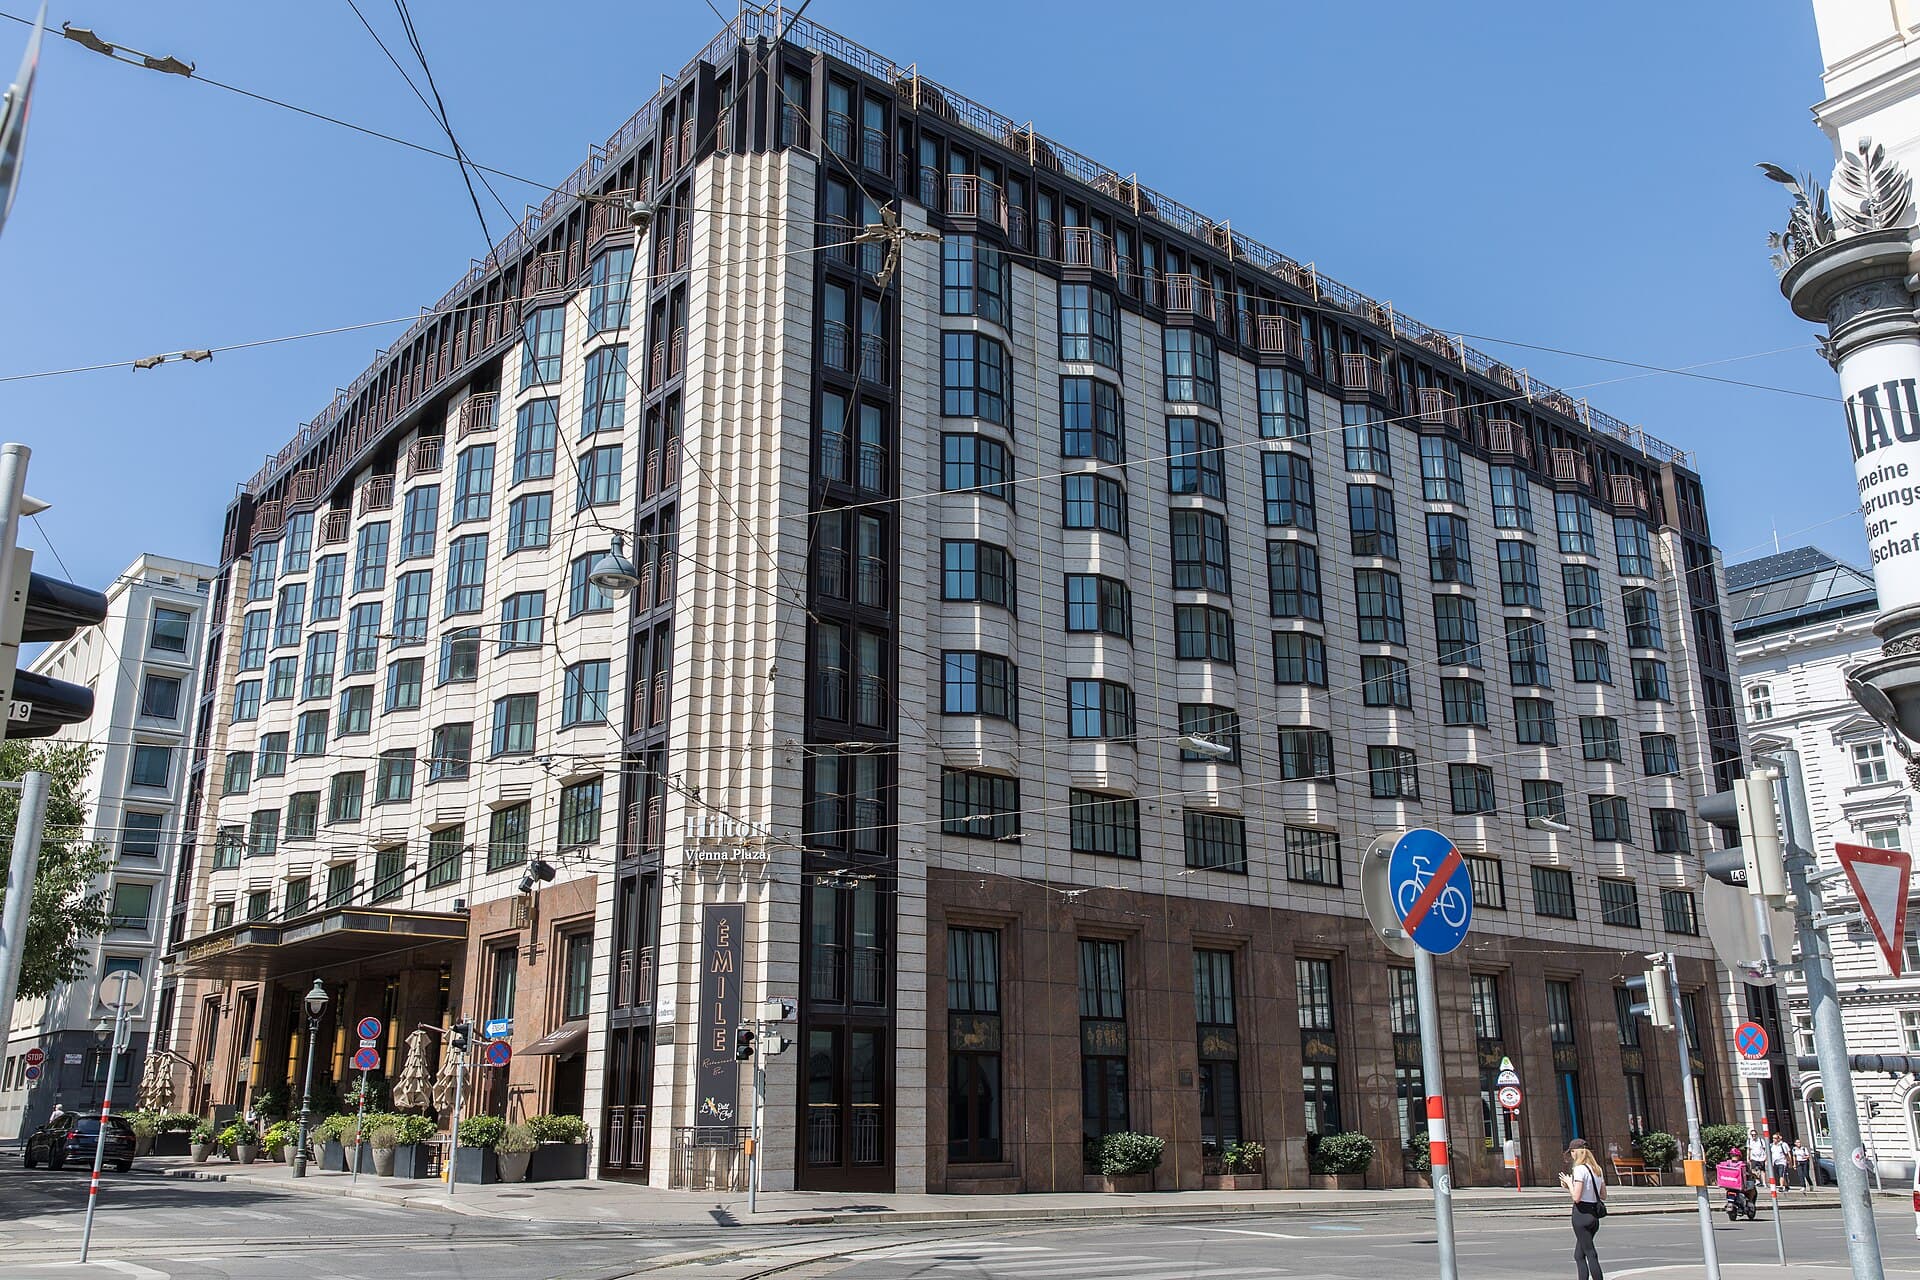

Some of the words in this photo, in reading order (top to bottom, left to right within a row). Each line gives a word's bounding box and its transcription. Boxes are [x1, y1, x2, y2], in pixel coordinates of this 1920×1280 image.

[1857, 462, 1909, 496] meine
[9, 702, 29, 718] 19
[686, 815, 768, 838] Hilton
[685, 848, 728, 861] Vienna
[732, 848, 767, 860] Plaza
[1732, 870, 1746, 881] 48
[711, 918, 733, 1051] ÉMILE
[27, 1053, 43, 1061] STOP
